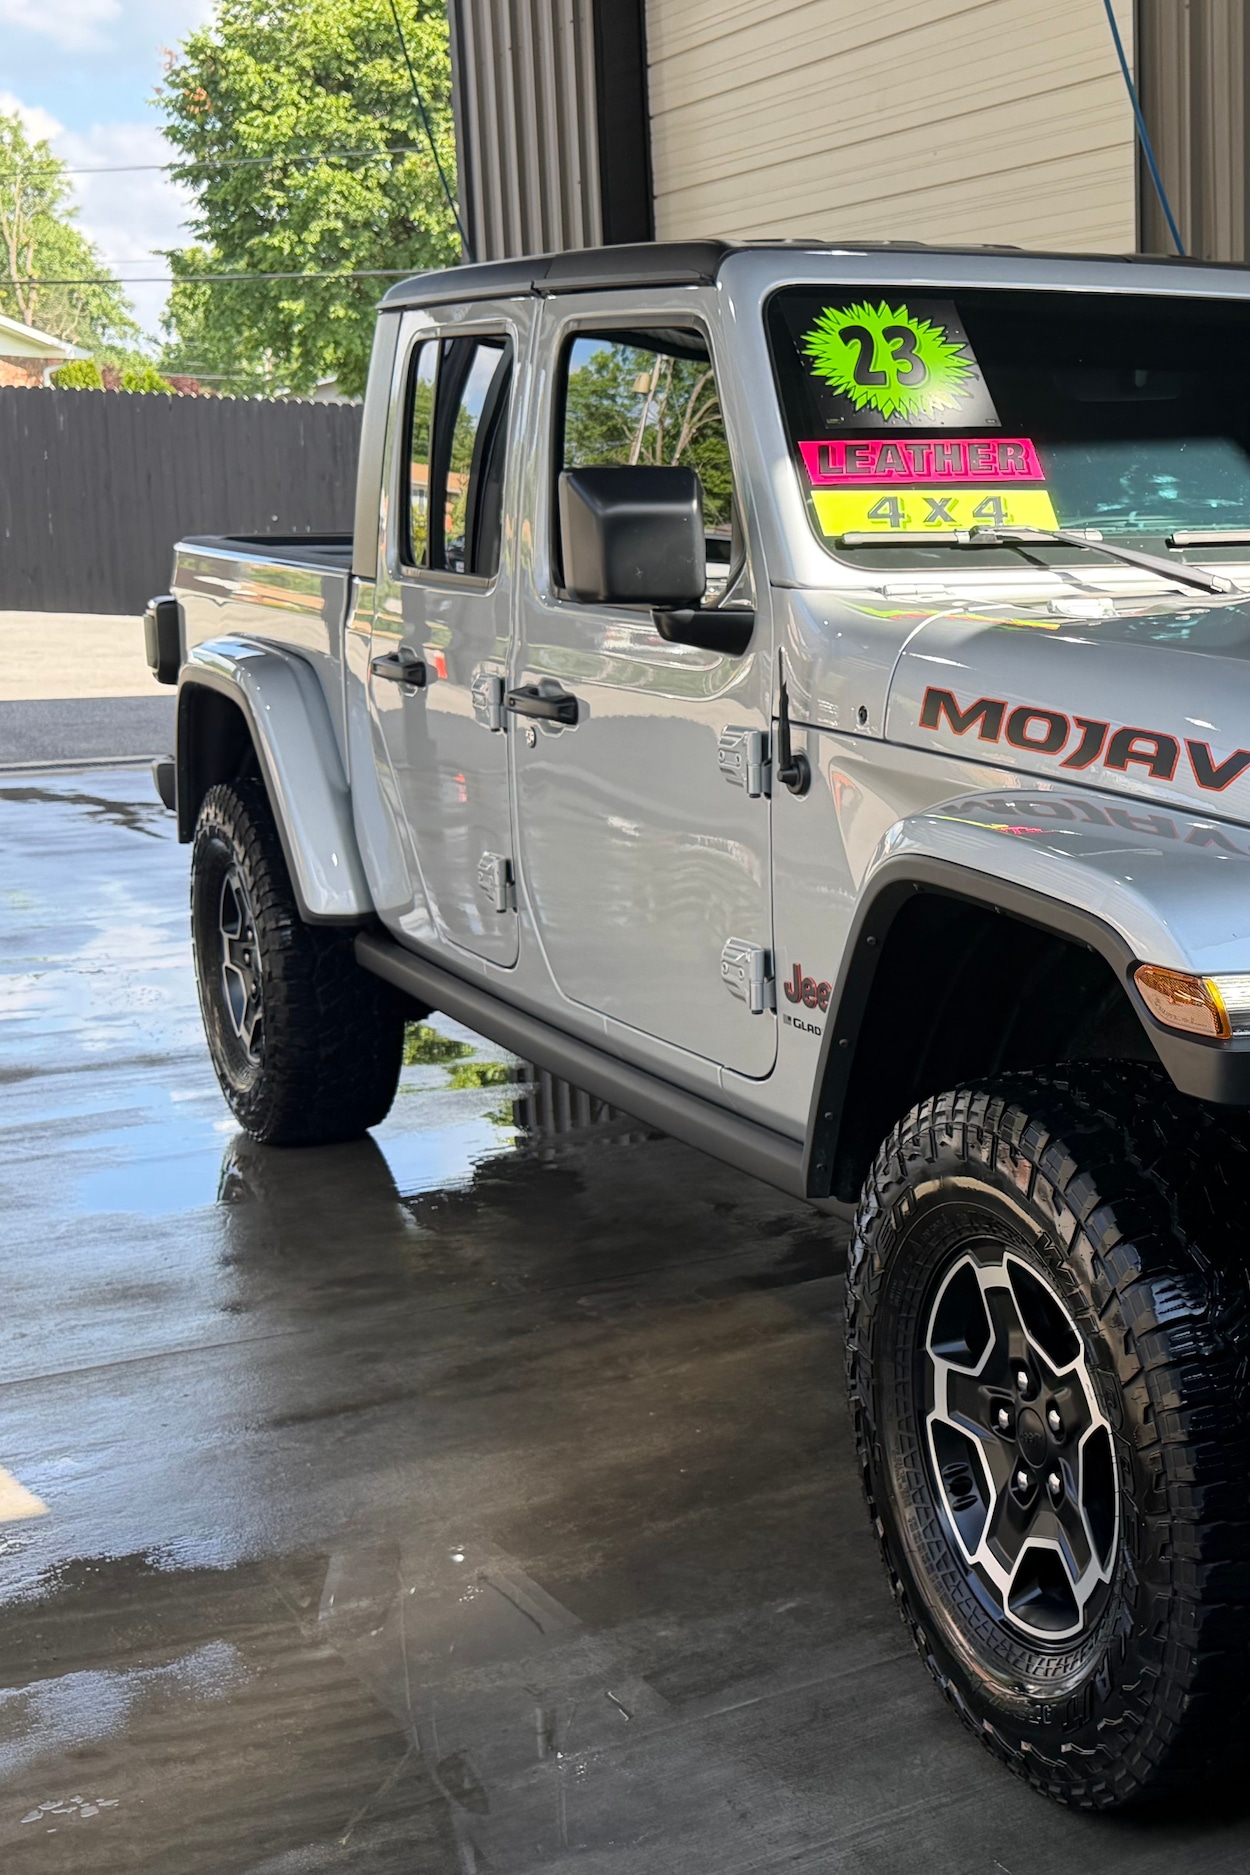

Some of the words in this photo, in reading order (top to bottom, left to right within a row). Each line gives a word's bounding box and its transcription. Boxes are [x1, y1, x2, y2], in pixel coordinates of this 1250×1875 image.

[838, 324, 927, 387] 23
[816, 442, 1030, 476] LEATHER
[783, 962, 832, 1013] Jee
[793, 1018, 822, 1036] GLAD
